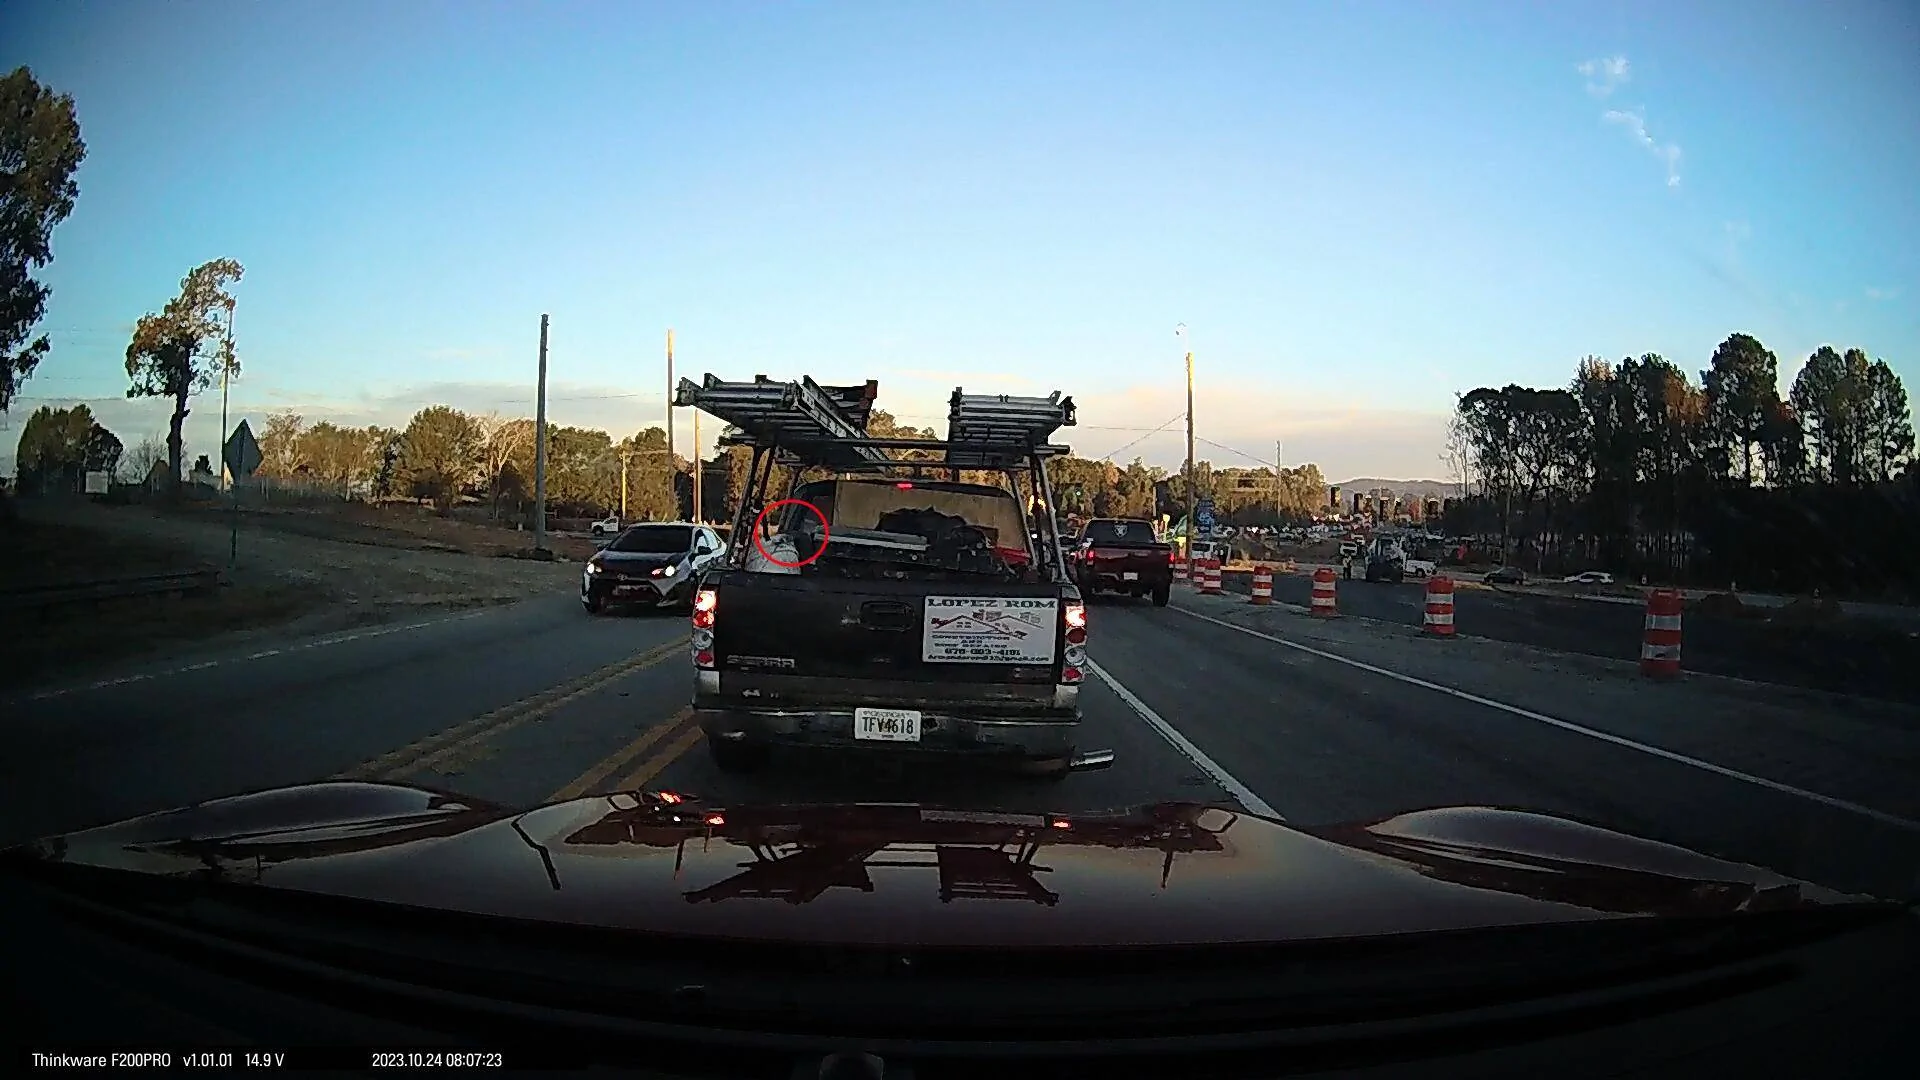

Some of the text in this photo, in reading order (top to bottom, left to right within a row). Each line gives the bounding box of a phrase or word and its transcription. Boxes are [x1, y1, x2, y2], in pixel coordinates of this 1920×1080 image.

[927, 599, 1056, 608] LOPEZ ROM
[861, 716, 914, 734] TFV4618
